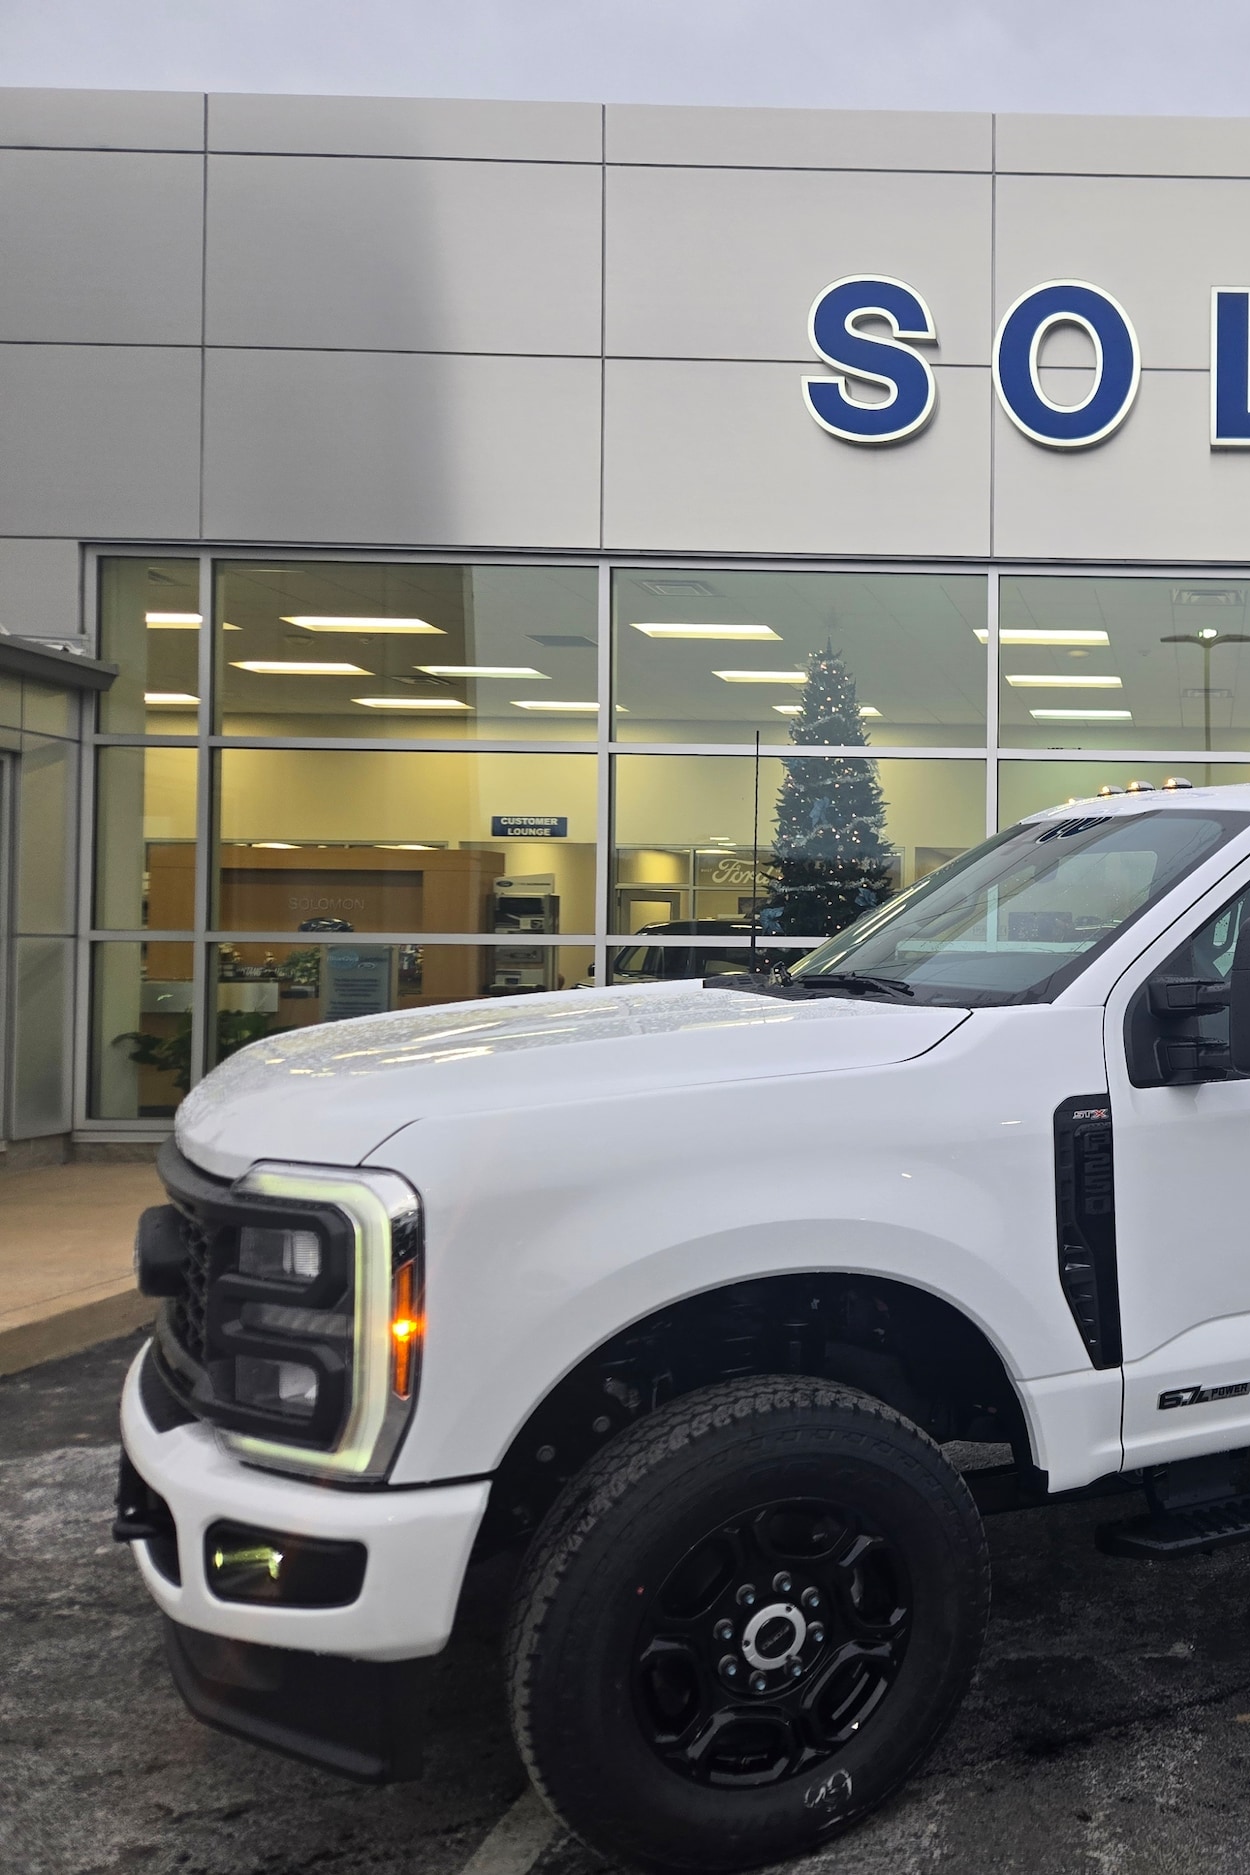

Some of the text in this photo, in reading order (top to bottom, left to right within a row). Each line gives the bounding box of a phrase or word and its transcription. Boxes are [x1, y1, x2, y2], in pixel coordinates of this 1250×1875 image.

[500, 817, 559, 826] CUSTOMER
[507, 828, 552, 836] LOUNGE
[288, 897, 365, 910] SOLOMON
[1073, 1109, 1109, 1120] STX
[1157, 1385, 1210, 1410] 6.7L
[1211, 1383, 1248, 1397] POWER
